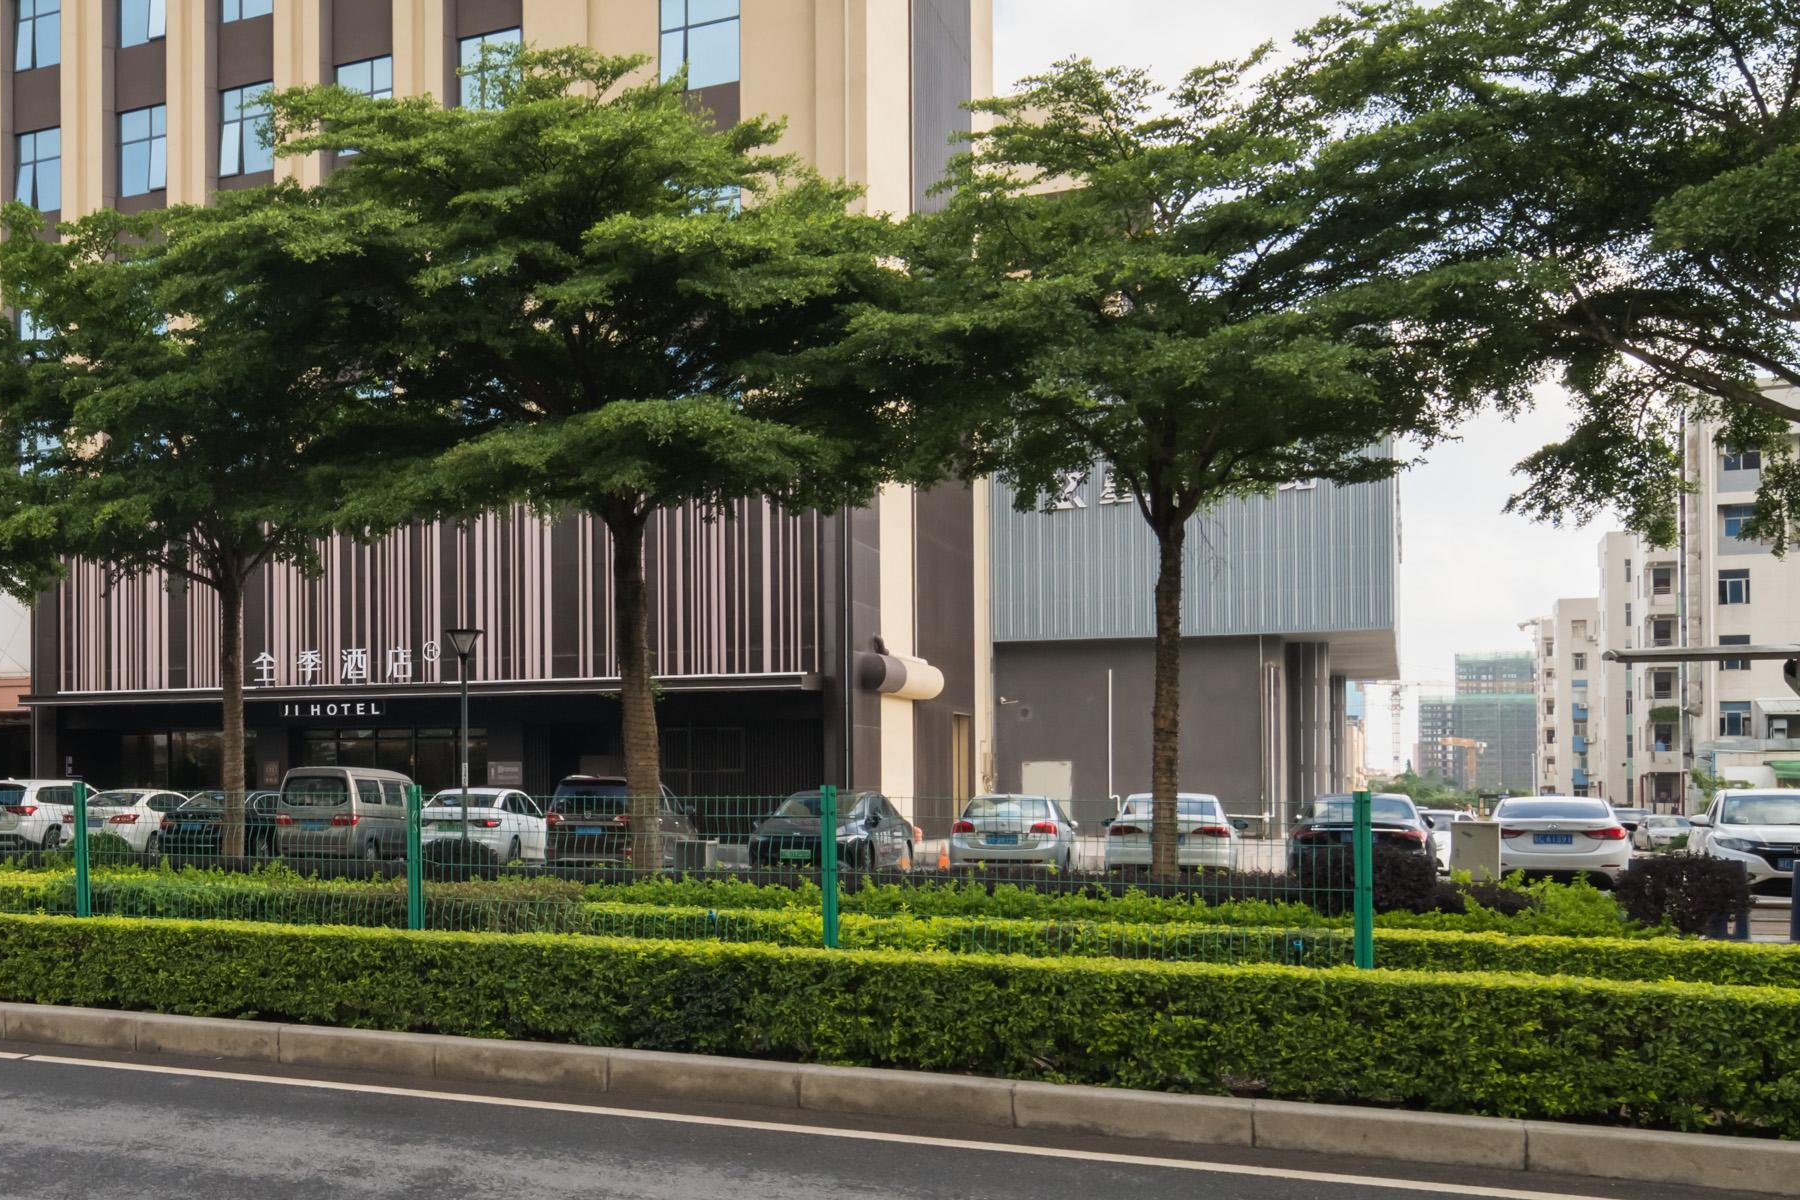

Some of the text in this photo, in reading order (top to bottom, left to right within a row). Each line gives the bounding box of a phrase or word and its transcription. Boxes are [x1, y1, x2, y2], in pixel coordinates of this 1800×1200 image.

[252, 647, 413, 682] 全季酒店
[284, 703, 380, 716] JI HOTEL
